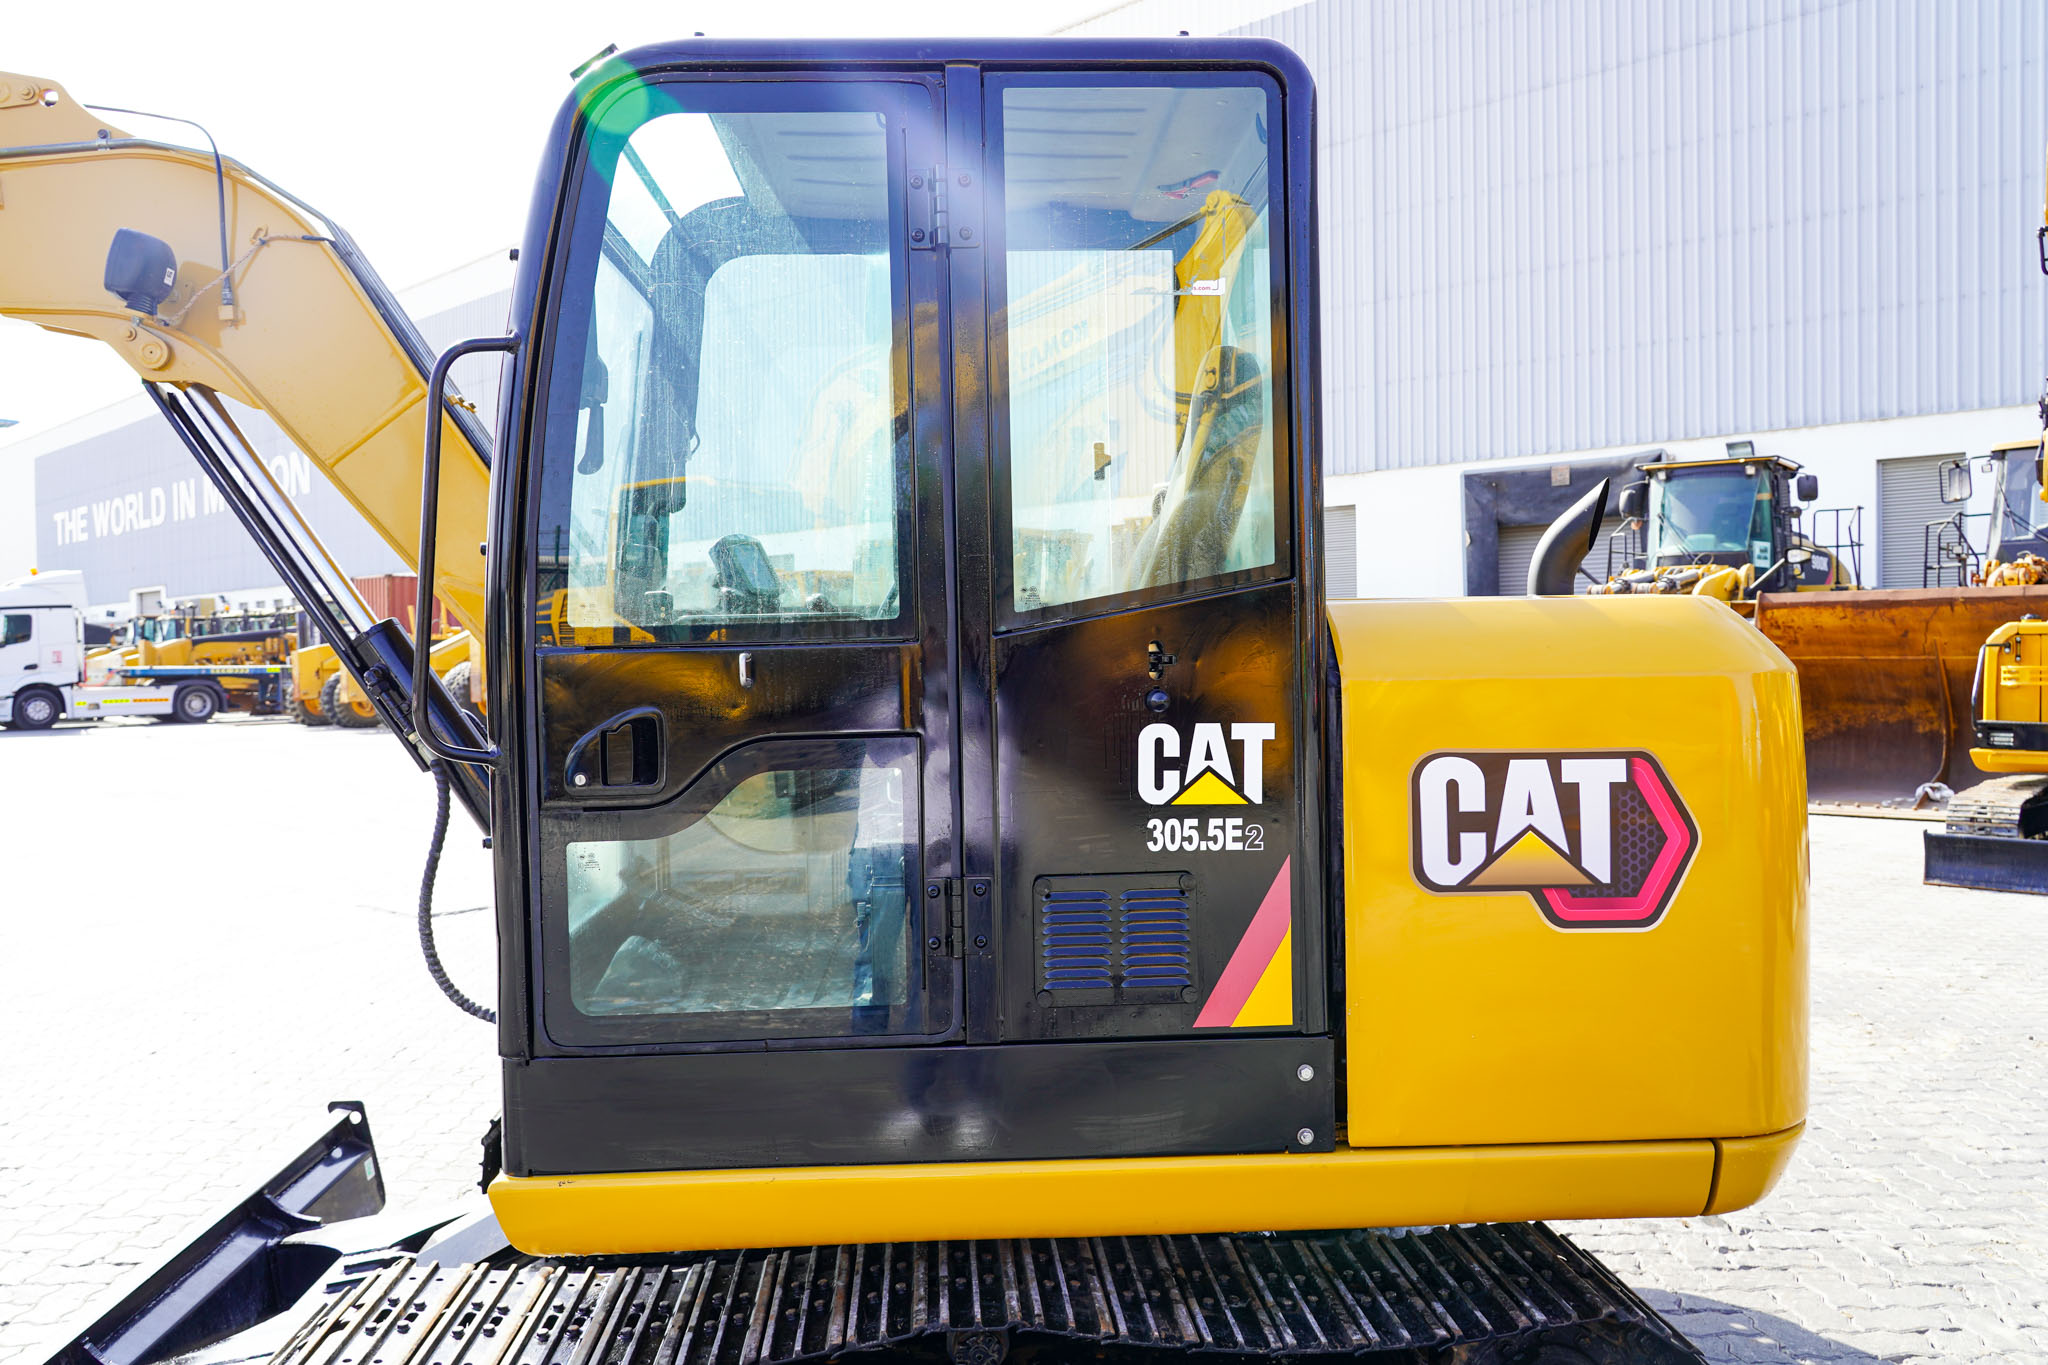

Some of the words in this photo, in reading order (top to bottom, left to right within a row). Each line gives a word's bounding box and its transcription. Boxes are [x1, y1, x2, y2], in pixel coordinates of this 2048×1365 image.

[53, 505, 89, 546] THE
[92, 486, 166, 538] WORLD
[172, 478, 196, 522] IN
[203, 451, 311, 515] MON
[1138, 723, 1275, 805] CAT
[1146, 818, 1264, 852] 305.5E2
[1419, 756, 1627, 886] CAT
